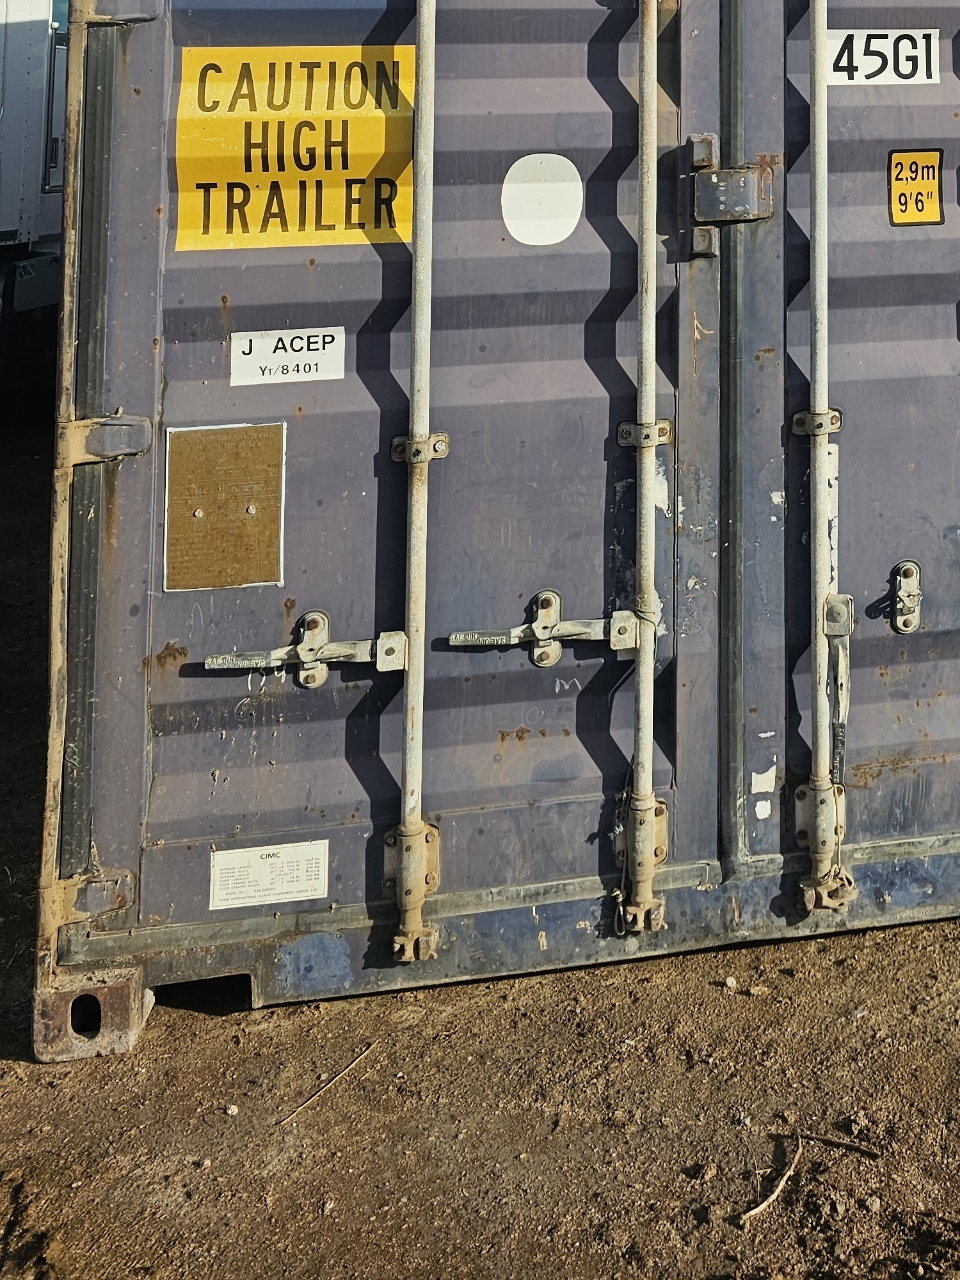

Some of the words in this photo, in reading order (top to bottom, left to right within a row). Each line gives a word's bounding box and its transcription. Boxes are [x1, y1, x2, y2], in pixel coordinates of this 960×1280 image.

[832, 33, 933, 81] 45G1
[197, 60, 400, 113] CAUTION
[244, 119, 350, 174] HIGH
[195, 177, 398, 236] TRAILER
[242, 339, 252, 355] J
[272, 334, 335, 353] ACEP
[260, 852, 281, 860] CIMC
